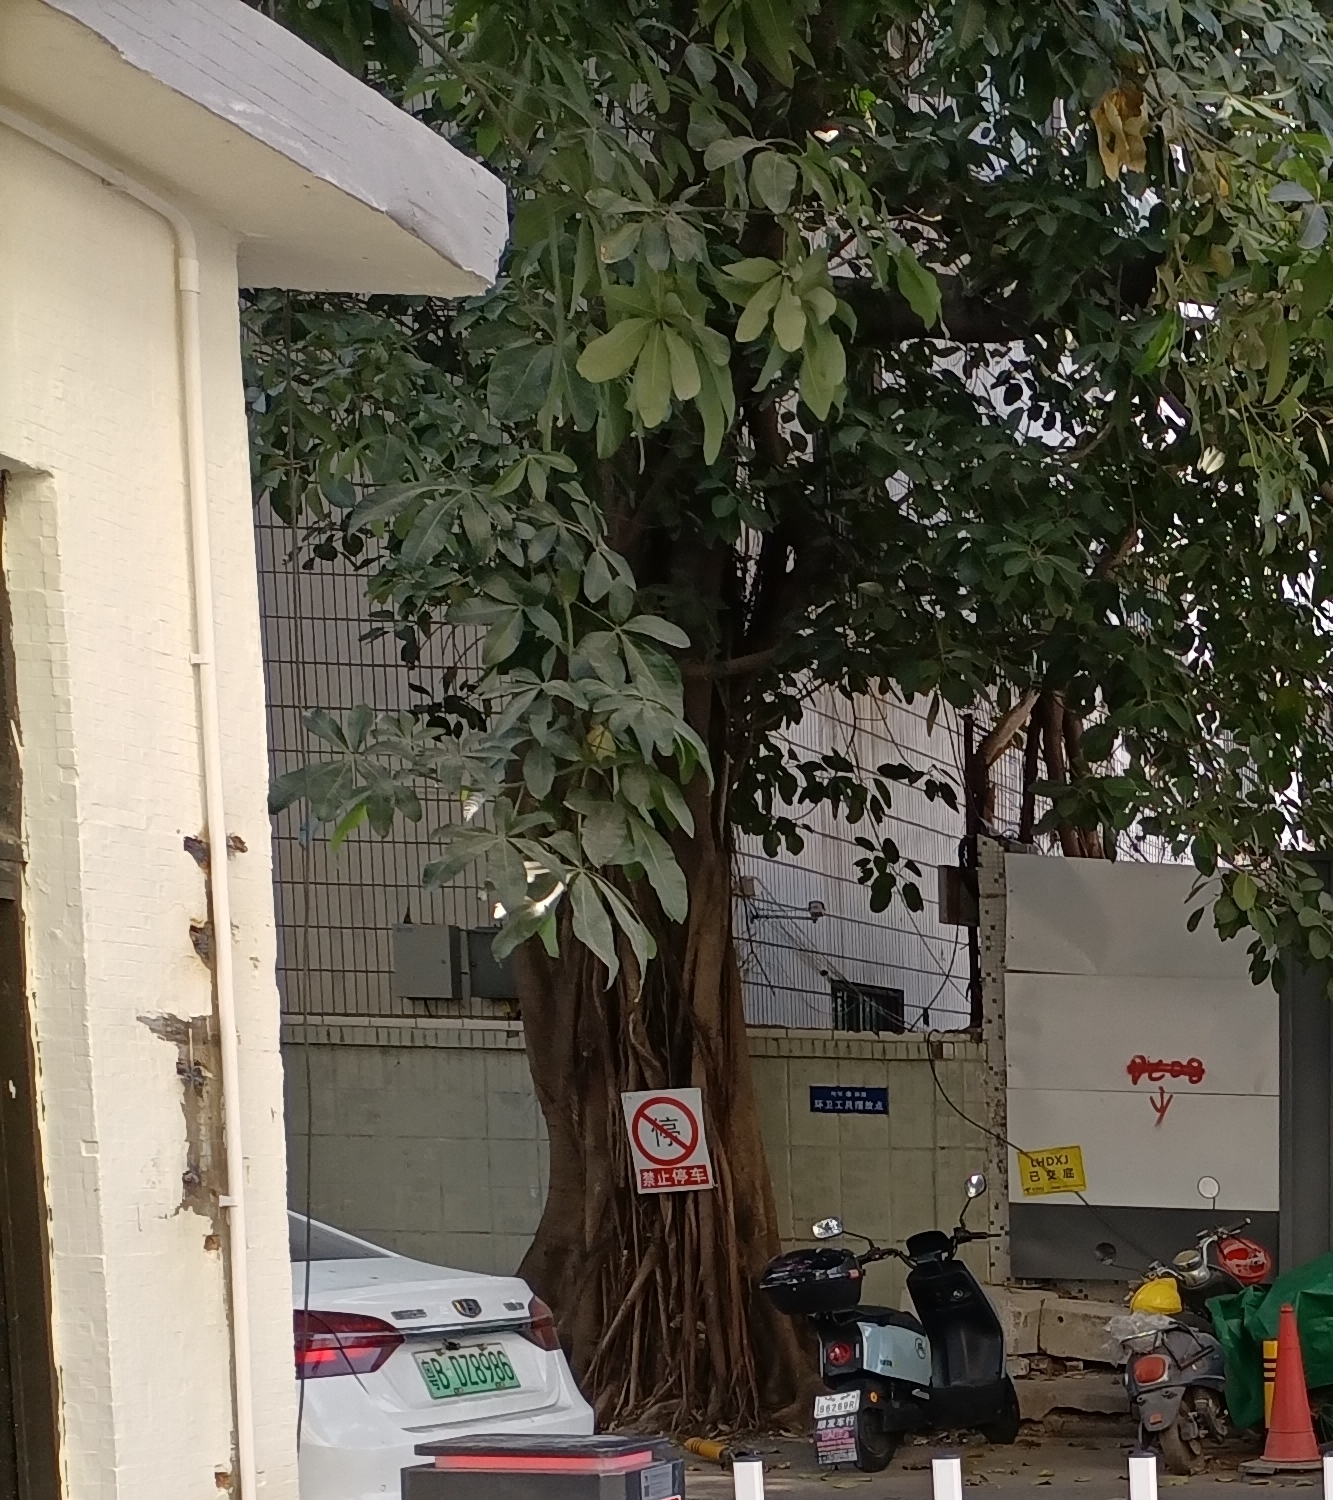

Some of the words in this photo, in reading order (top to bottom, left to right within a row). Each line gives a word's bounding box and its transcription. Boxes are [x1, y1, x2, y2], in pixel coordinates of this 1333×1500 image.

[1031, 1154, 1070, 1168] LHDXJ
[642, 1167, 707, 1188] 禁止停车
